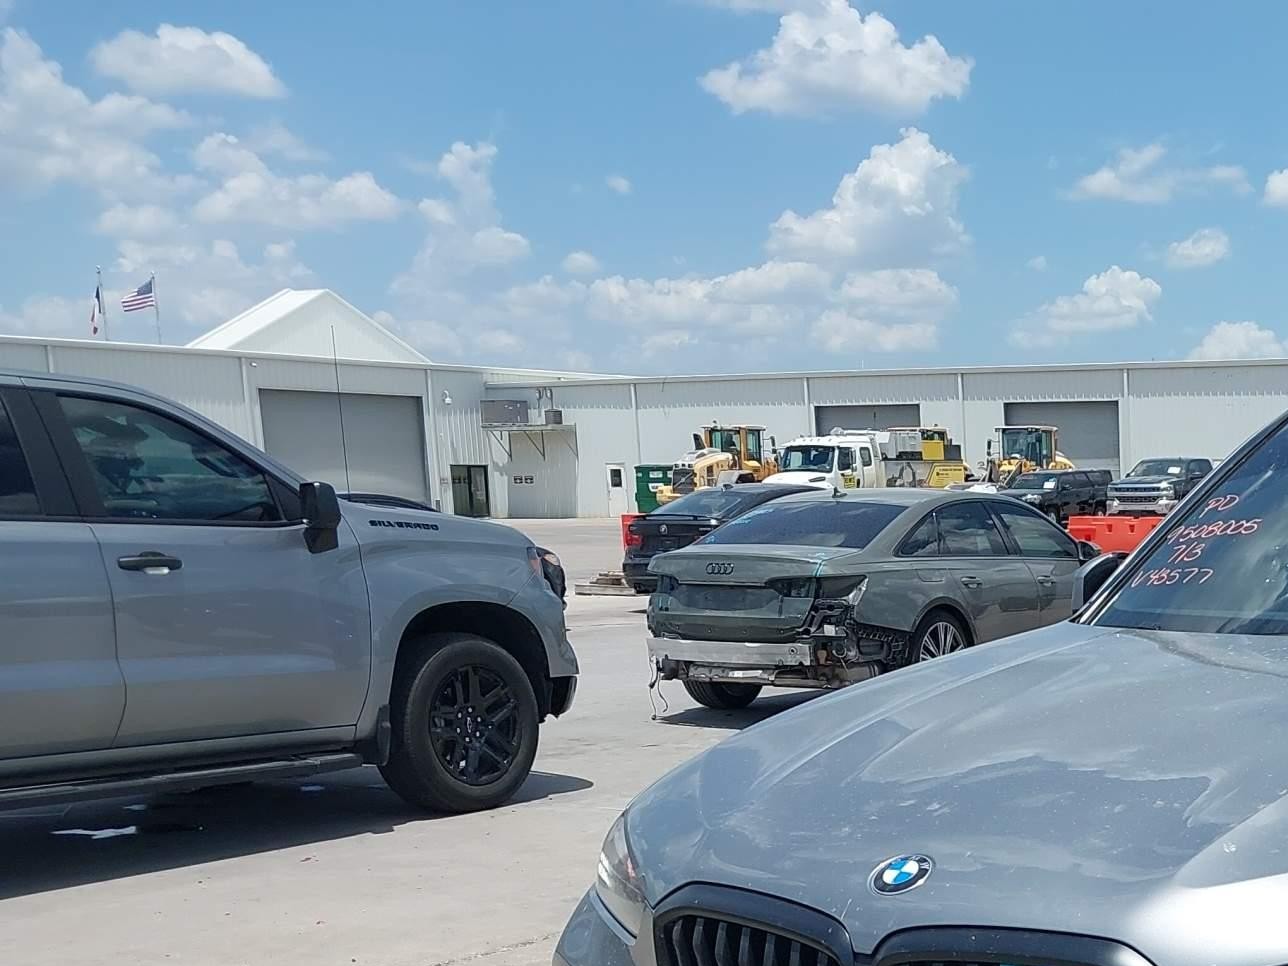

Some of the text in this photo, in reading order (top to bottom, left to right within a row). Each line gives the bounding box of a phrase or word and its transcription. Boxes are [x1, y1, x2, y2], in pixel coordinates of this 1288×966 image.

[1199, 494, 1239, 518] PD
[368, 520, 439, 531] SILVERADO
[1168, 542, 1205, 565] 7/3
